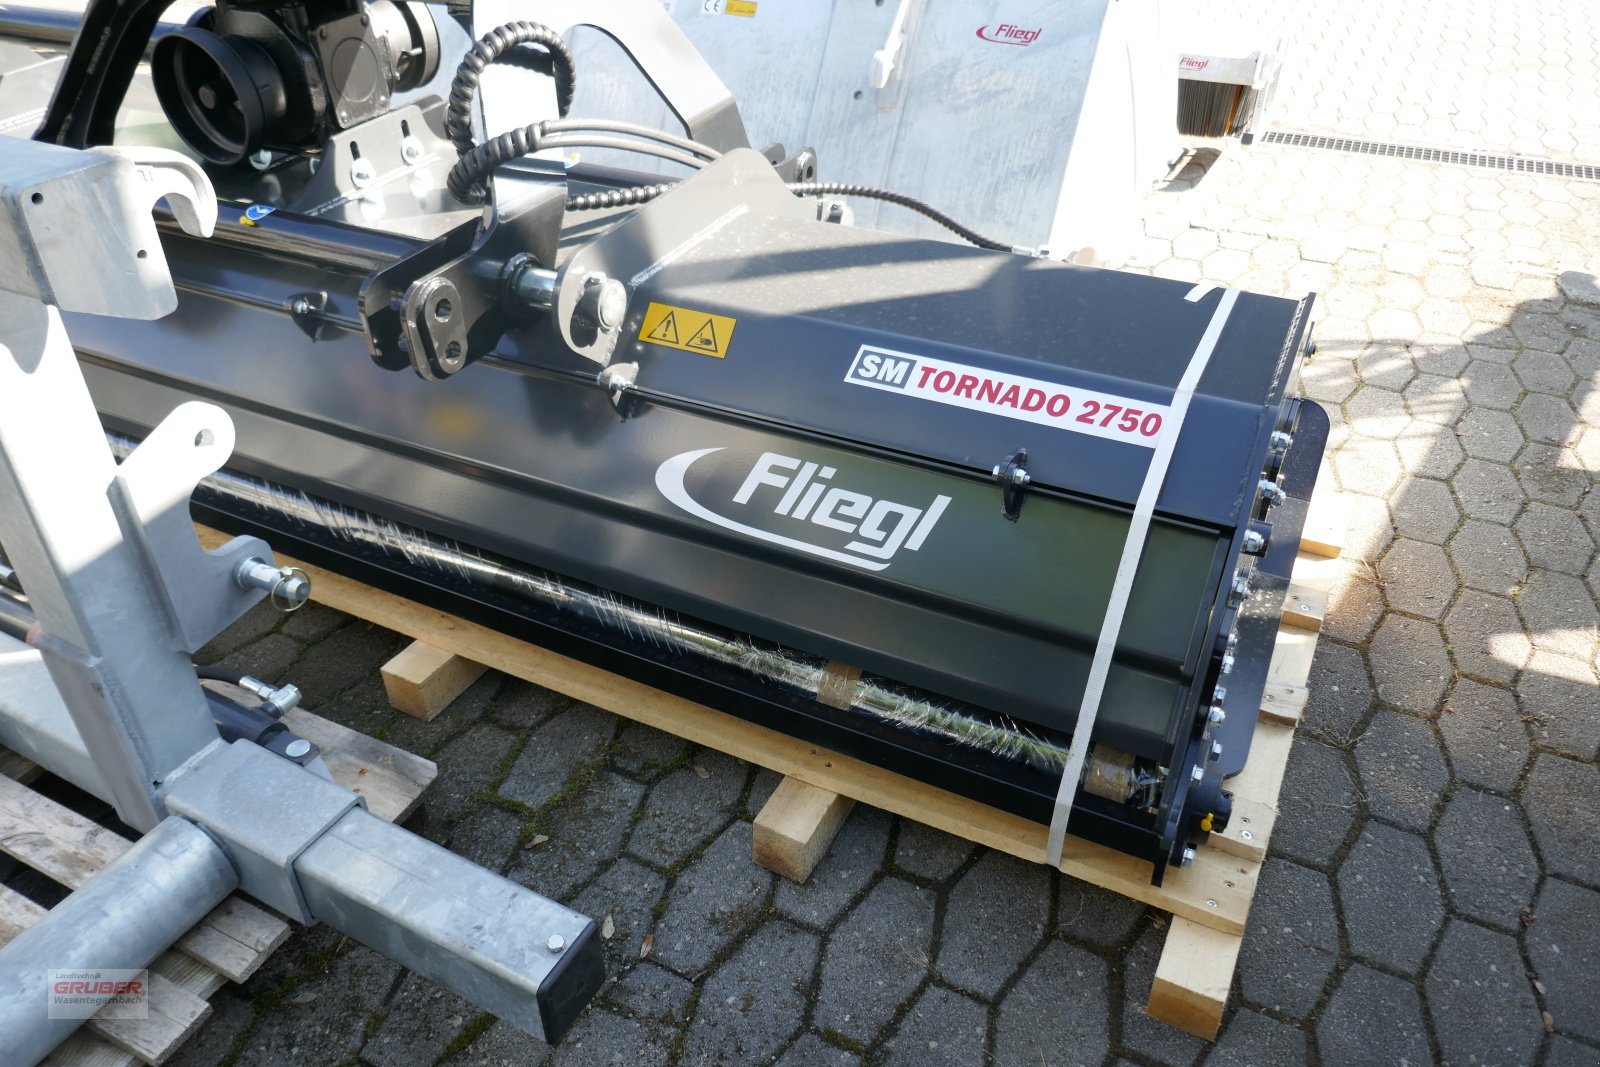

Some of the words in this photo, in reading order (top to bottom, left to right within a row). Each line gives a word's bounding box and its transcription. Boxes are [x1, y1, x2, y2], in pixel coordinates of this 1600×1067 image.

[995, 24, 1042, 43] Fliegl
[1180, 57, 1209, 69] Fliegl
[858, 354, 910, 385] SM
[916, 366, 1071, 417] TORNADO
[1075, 400, 1163, 437] 2750
[732, 452, 953, 560] Fliegl
